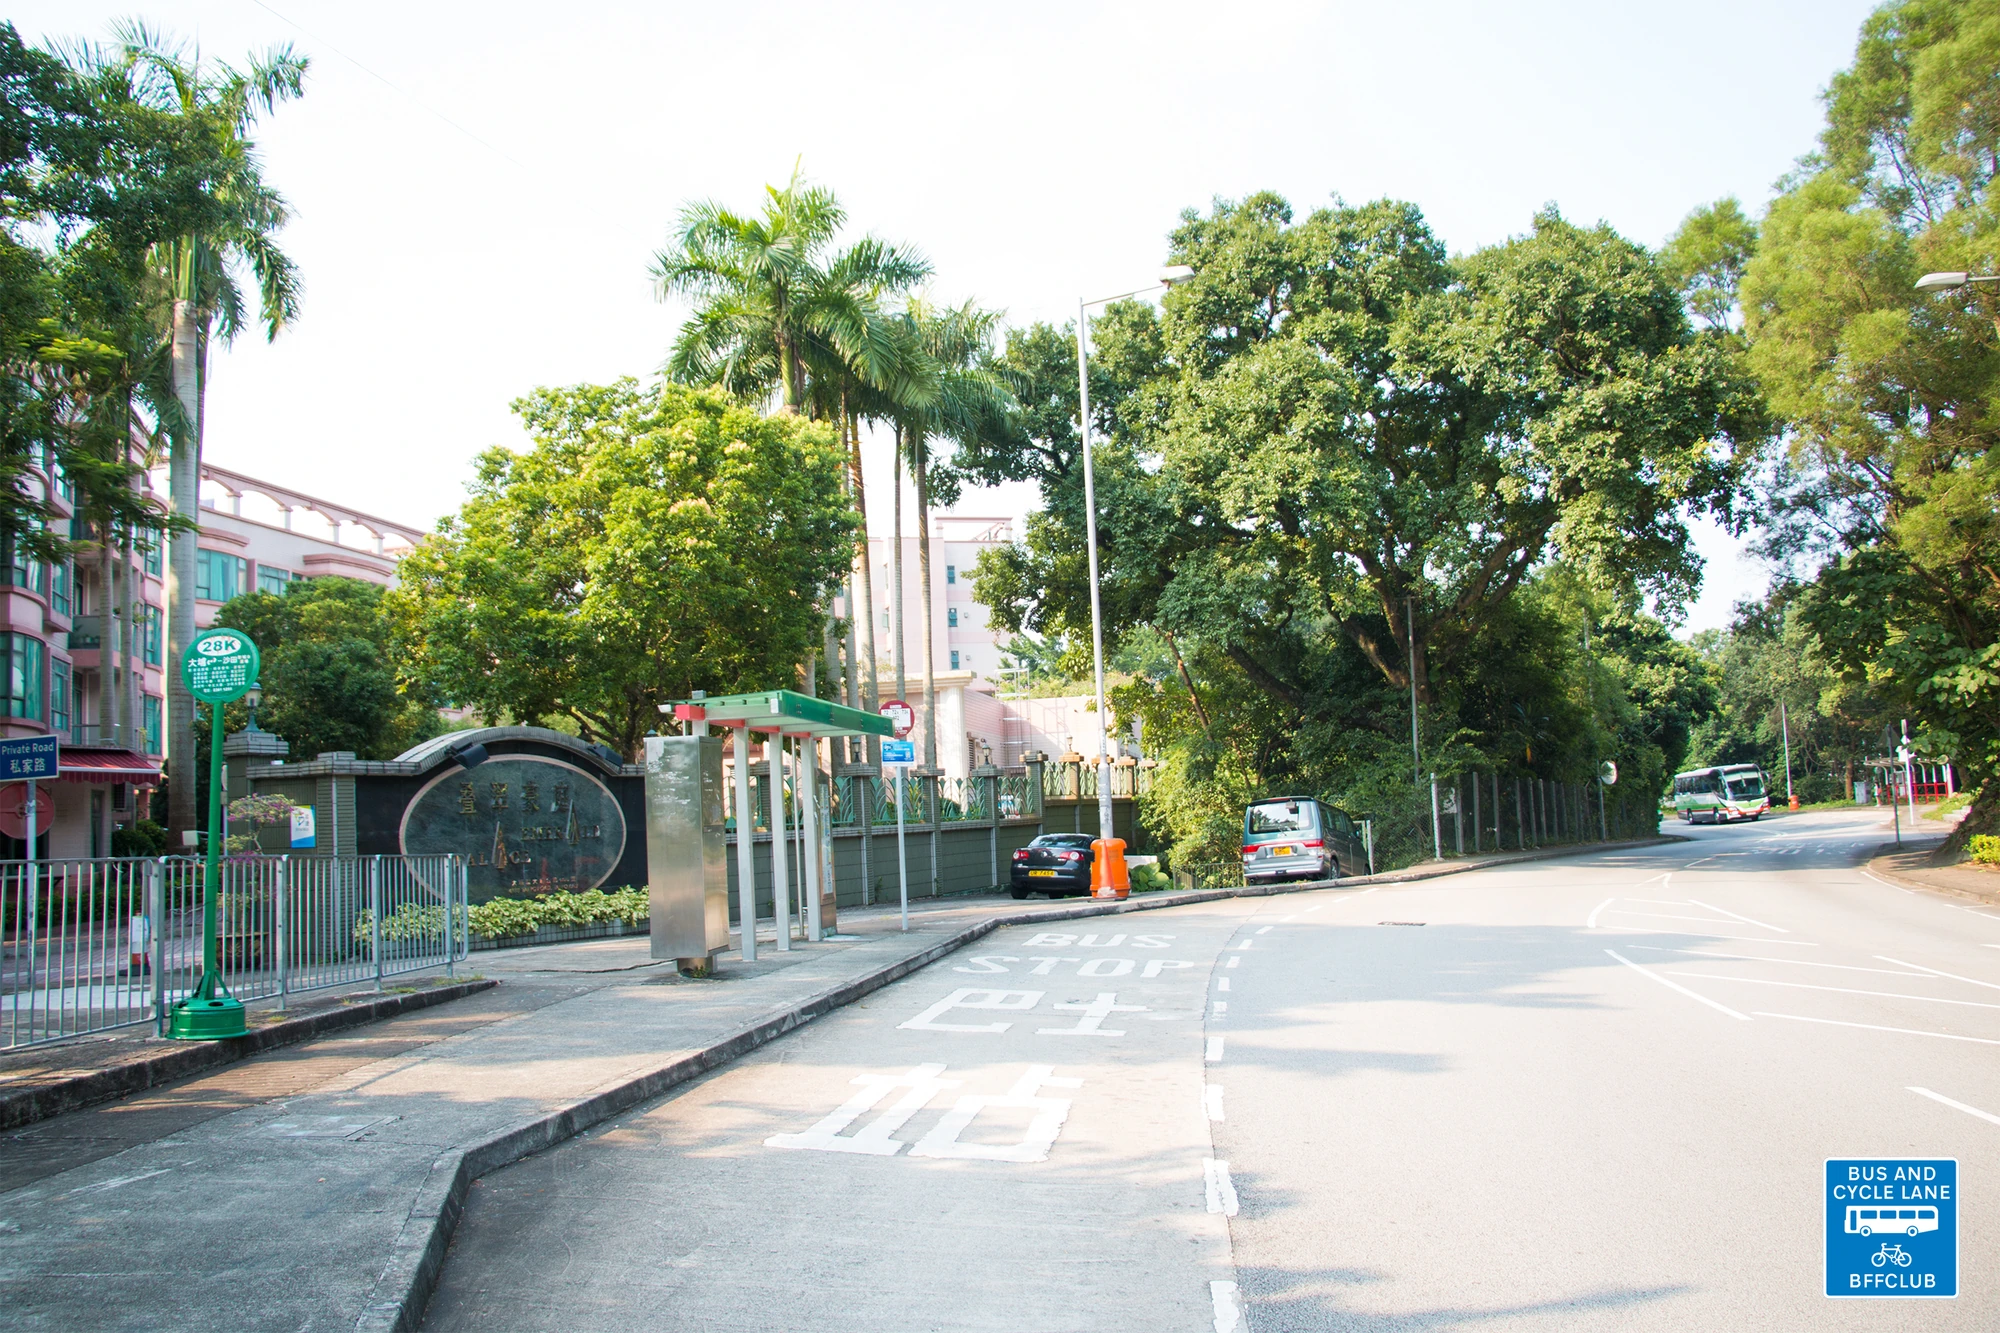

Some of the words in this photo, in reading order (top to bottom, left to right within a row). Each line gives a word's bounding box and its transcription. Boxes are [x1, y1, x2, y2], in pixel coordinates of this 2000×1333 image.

[202, 639, 236, 652] 28K
[1, 743, 30, 755] Private
[32, 742, 54, 752] Road
[9, 757, 46, 774] 私家路
[520, 799, 601, 846] EMERALD
[1021, 932, 1178, 949] BUS
[952, 955, 1195, 978] STOP
[895, 987, 1154, 1037] 巴士
[763, 1062, 1086, 1163] 站
